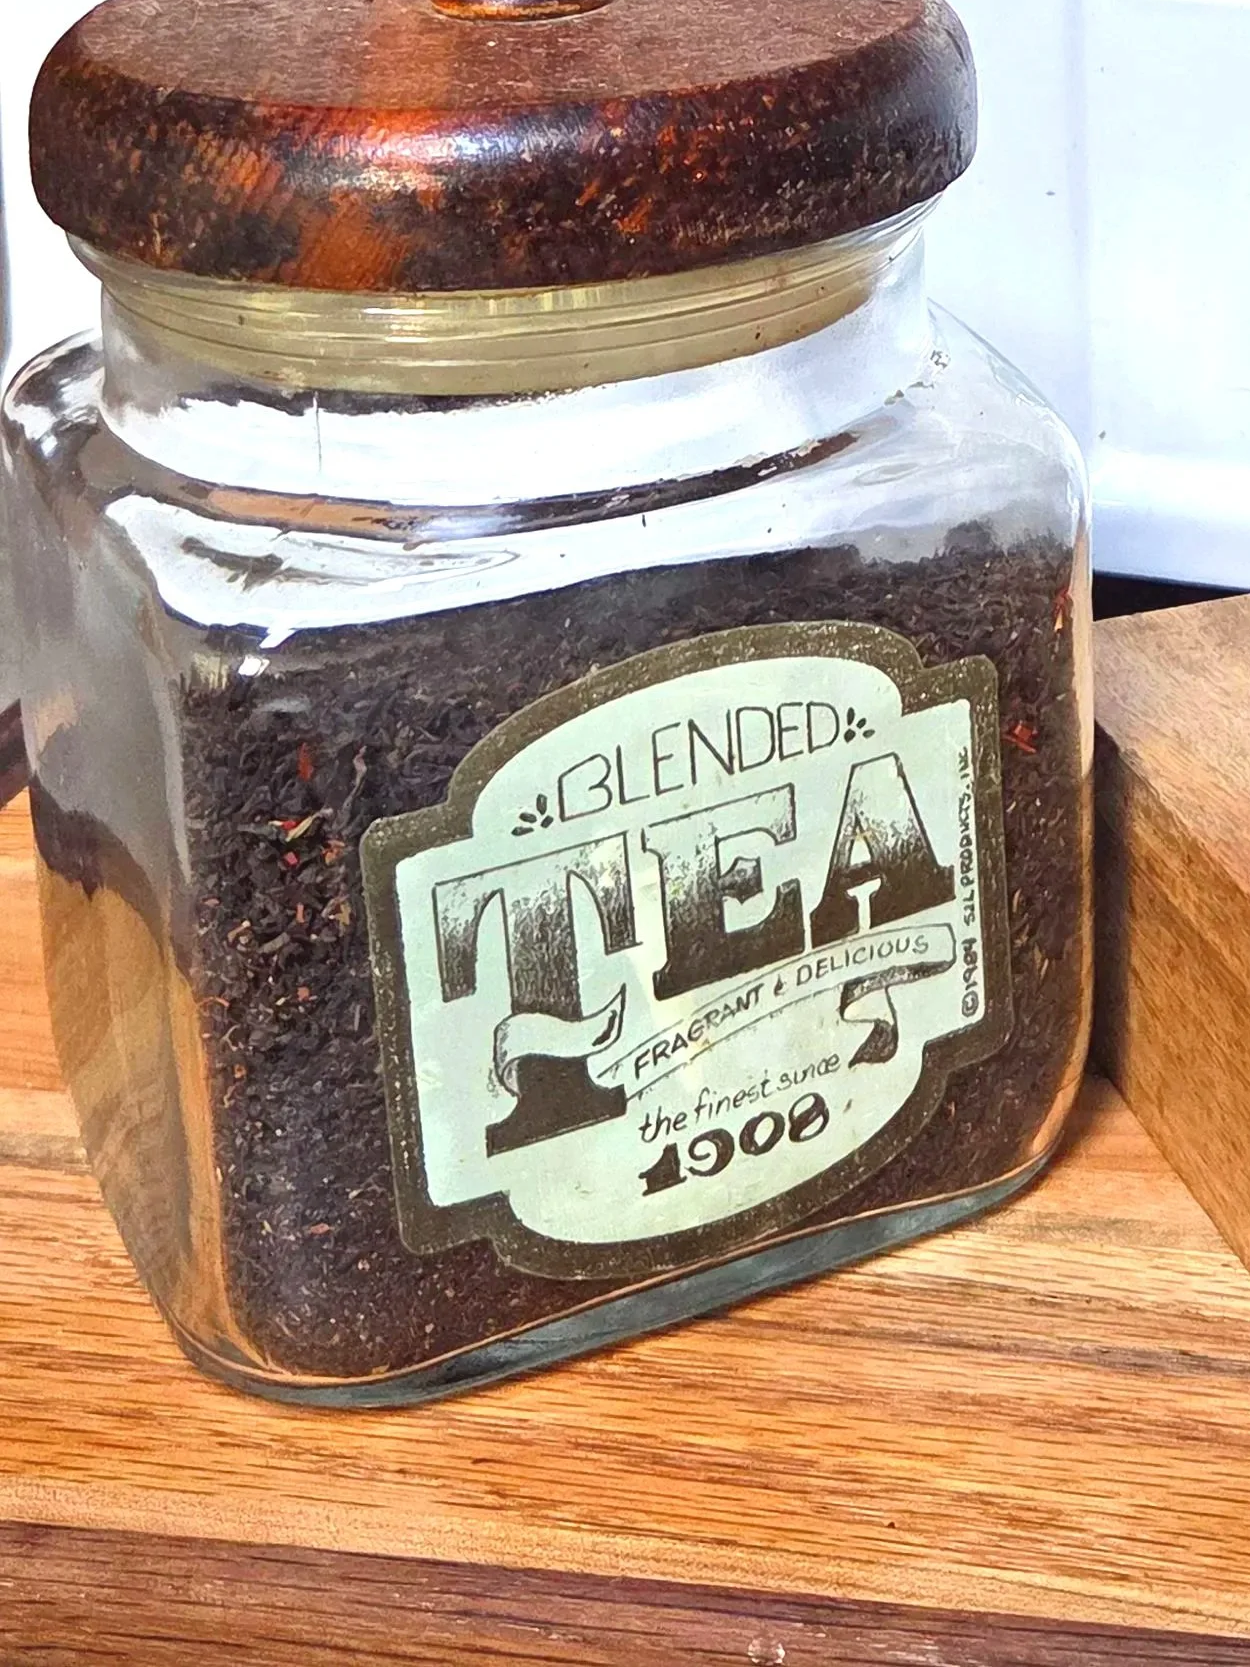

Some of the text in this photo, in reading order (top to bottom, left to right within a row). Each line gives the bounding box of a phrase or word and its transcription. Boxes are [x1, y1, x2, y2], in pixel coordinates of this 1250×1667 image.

[558, 702, 838, 822] BLENDED
[433, 751, 957, 1157] TEA
[633, 985, 763, 1079] FRAGRANT
[796, 935, 929, 988] DELICIOUS
[638, 1053, 842, 1142] the finest since
[638, 1091, 831, 1197] 1908
